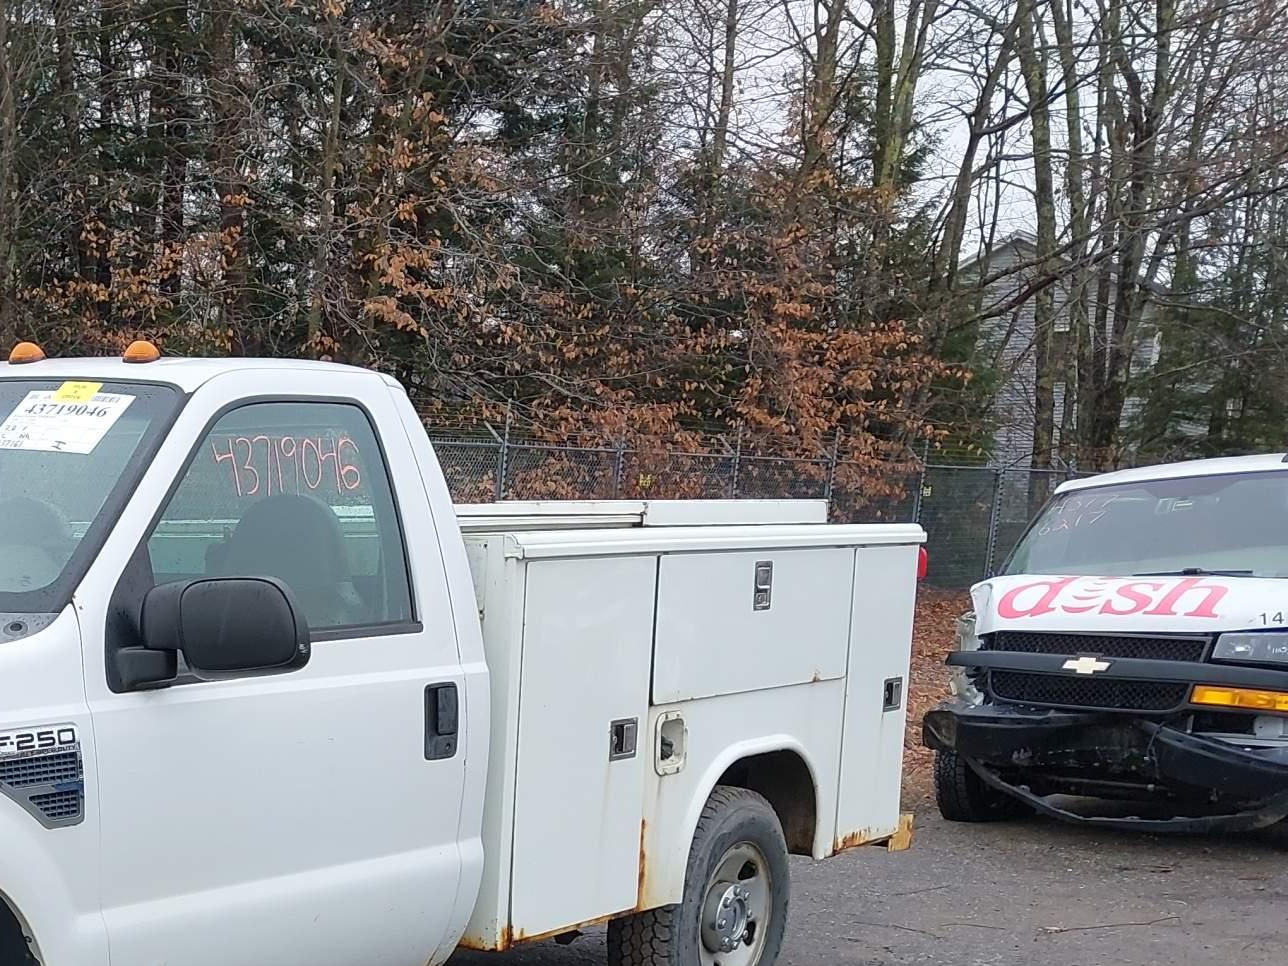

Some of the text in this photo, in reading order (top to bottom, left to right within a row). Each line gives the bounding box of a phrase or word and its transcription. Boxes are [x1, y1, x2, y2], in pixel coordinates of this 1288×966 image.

[24, 403, 112, 418] 43719046
[212, 435, 361, 497] 43719046
[997, 576, 1229, 620] dish
[1259, 611, 1286, 626] 14
